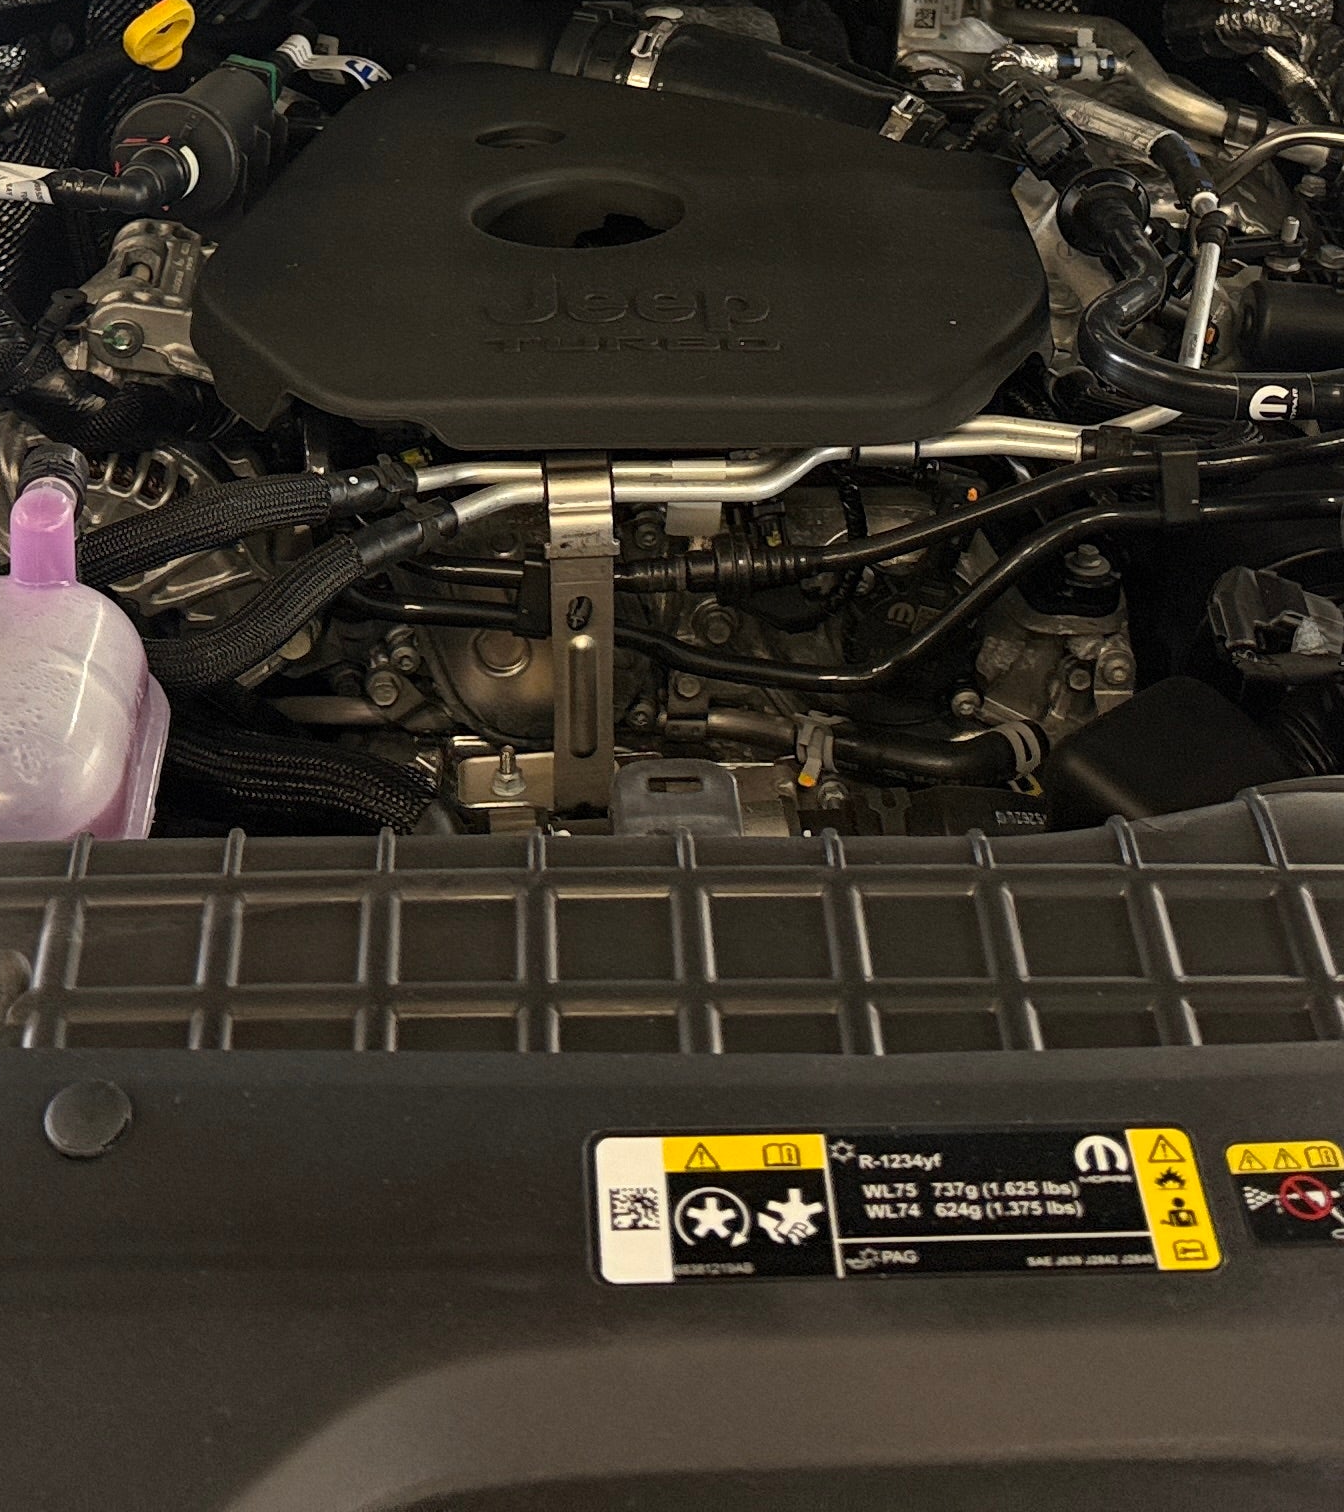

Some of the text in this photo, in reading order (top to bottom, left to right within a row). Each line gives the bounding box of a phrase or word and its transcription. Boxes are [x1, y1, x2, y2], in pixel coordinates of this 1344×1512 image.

[483, 272, 770, 333] Jeep
[483, 336, 783, 354] TURBO
[858, 1152, 943, 1172] R-1234yf
[862, 1180, 1079, 1201] WL75 737g (1.625 lbs)
[865, 1200, 1083, 1221] WL74 624g (1.375 lbs)
[882, 1248, 920, 1265] PAG
